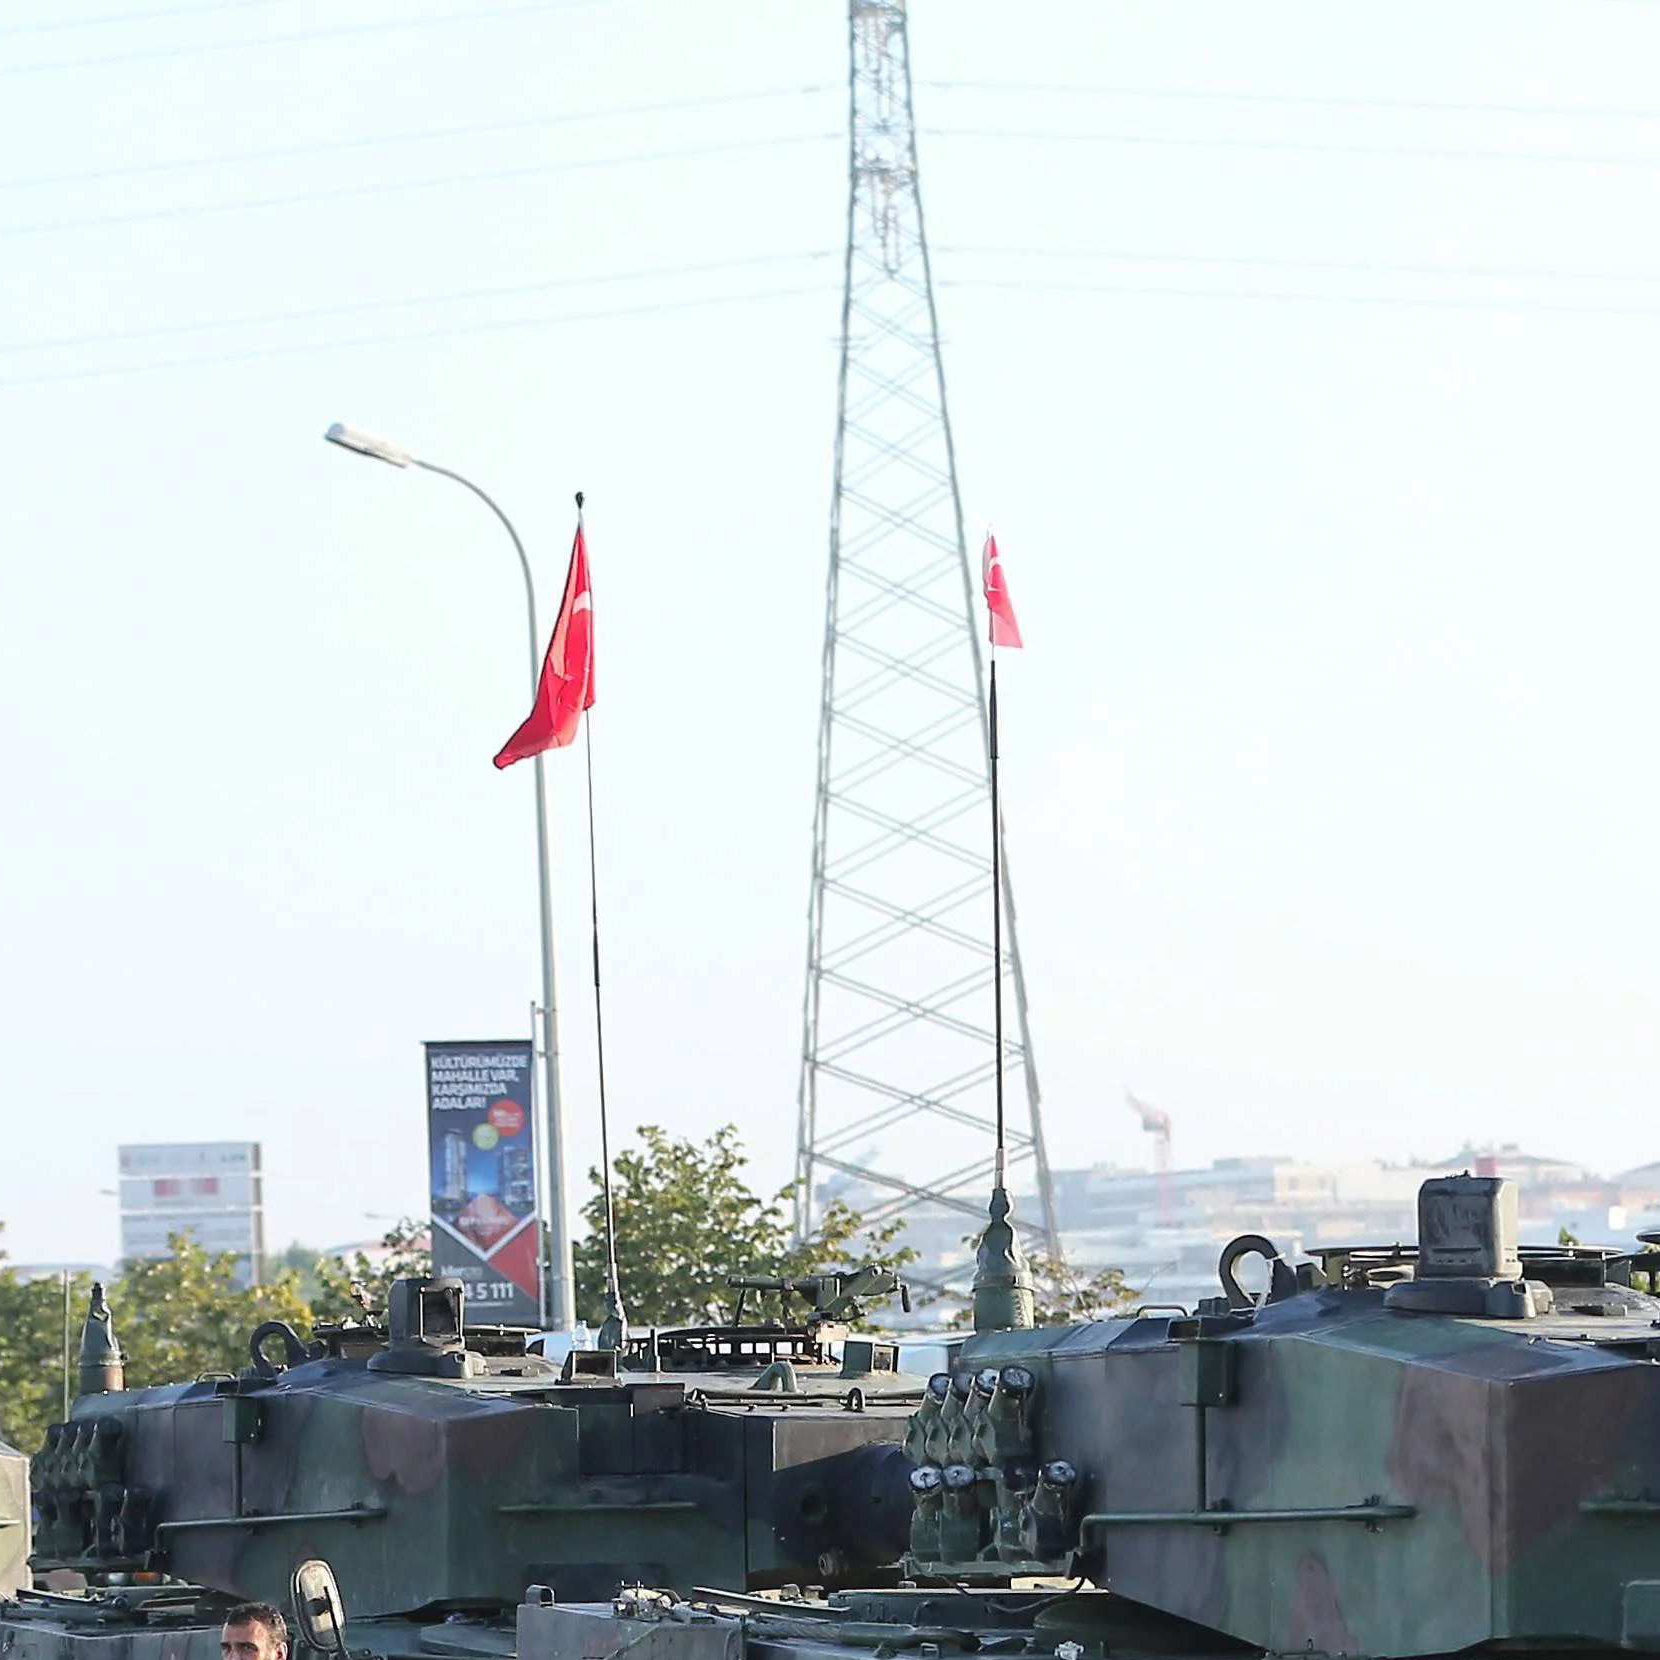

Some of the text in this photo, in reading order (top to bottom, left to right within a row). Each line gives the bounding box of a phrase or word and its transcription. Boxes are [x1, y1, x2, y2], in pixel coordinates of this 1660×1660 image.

[431, 1053, 527, 1069] KÜLTÜRÜMÜZDE
[431, 1070, 489, 1082] MAHALLE
[432, 1097, 486, 1109] ADALAR!
[476, 1283, 488, 1300] 5
[490, 1282, 514, 1299] 111
